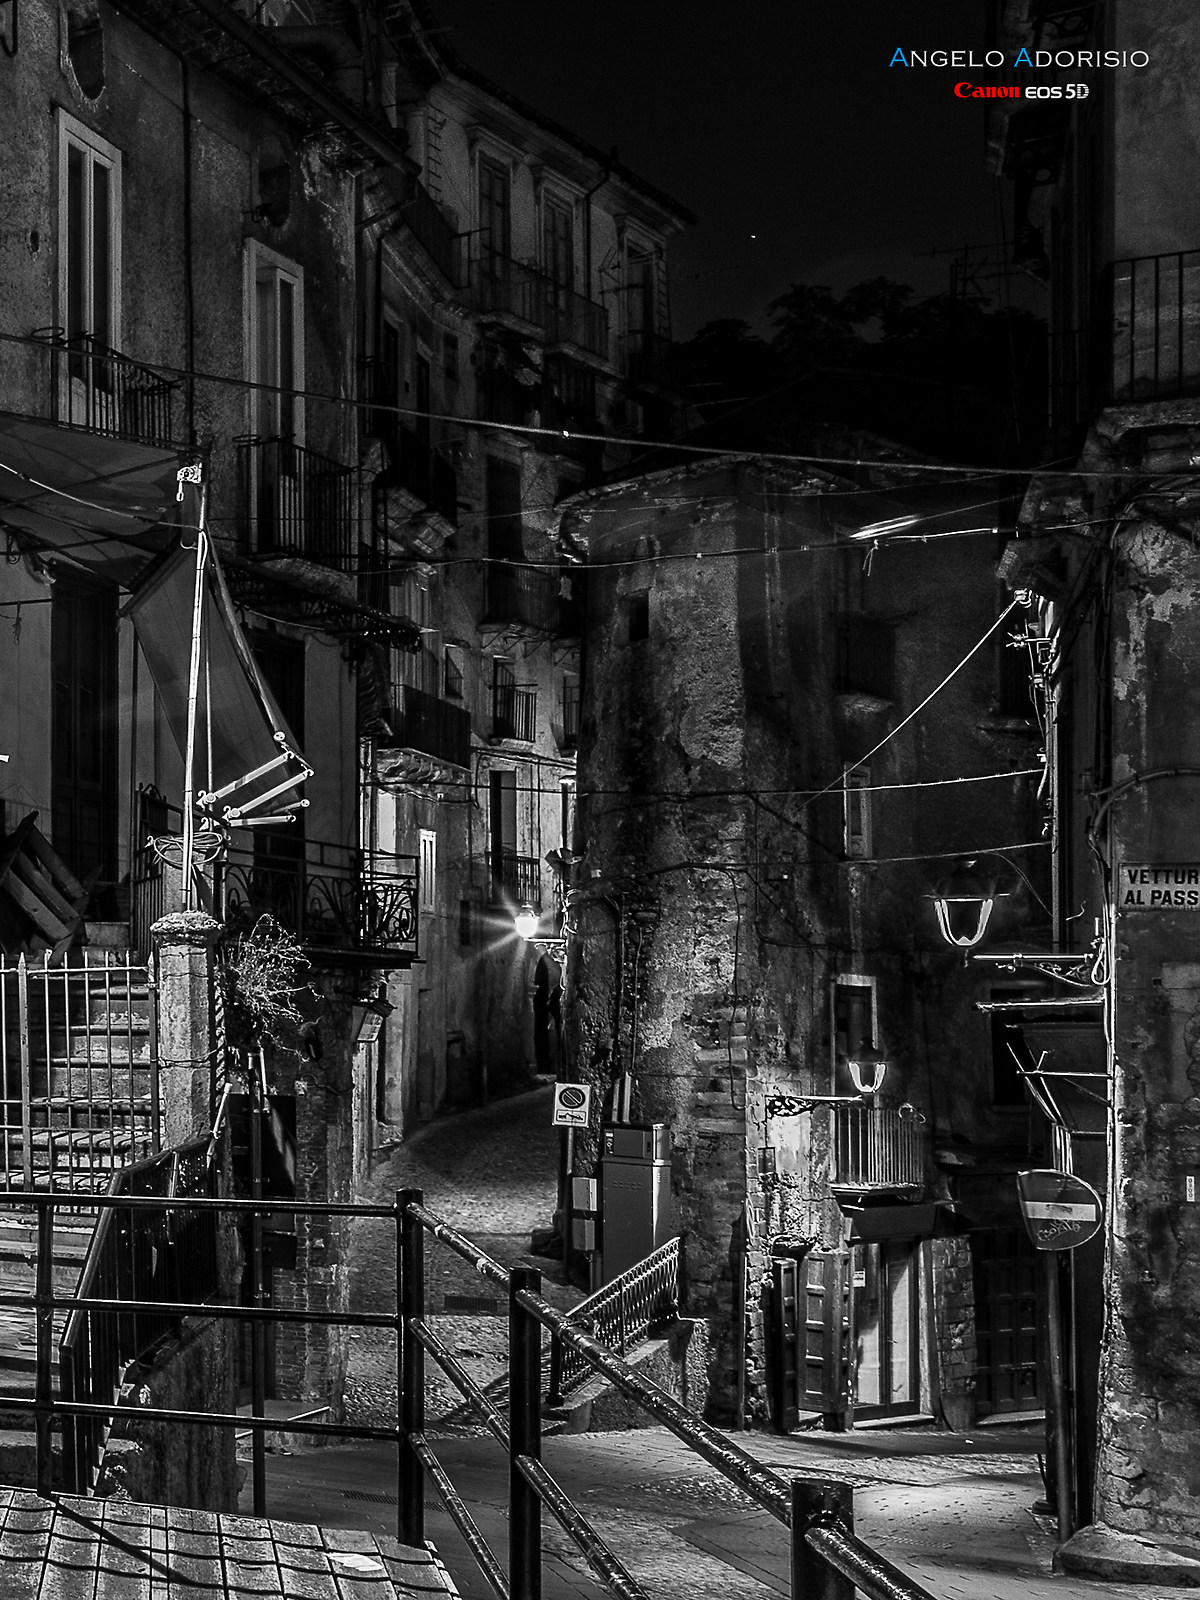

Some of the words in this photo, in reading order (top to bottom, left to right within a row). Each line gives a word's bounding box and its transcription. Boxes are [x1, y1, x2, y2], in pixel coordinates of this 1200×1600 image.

[1127, 869, 1199, 885] VETTUR
[1124, 890, 1145, 905] AL
[1150, 890, 1199, 906] PASS
